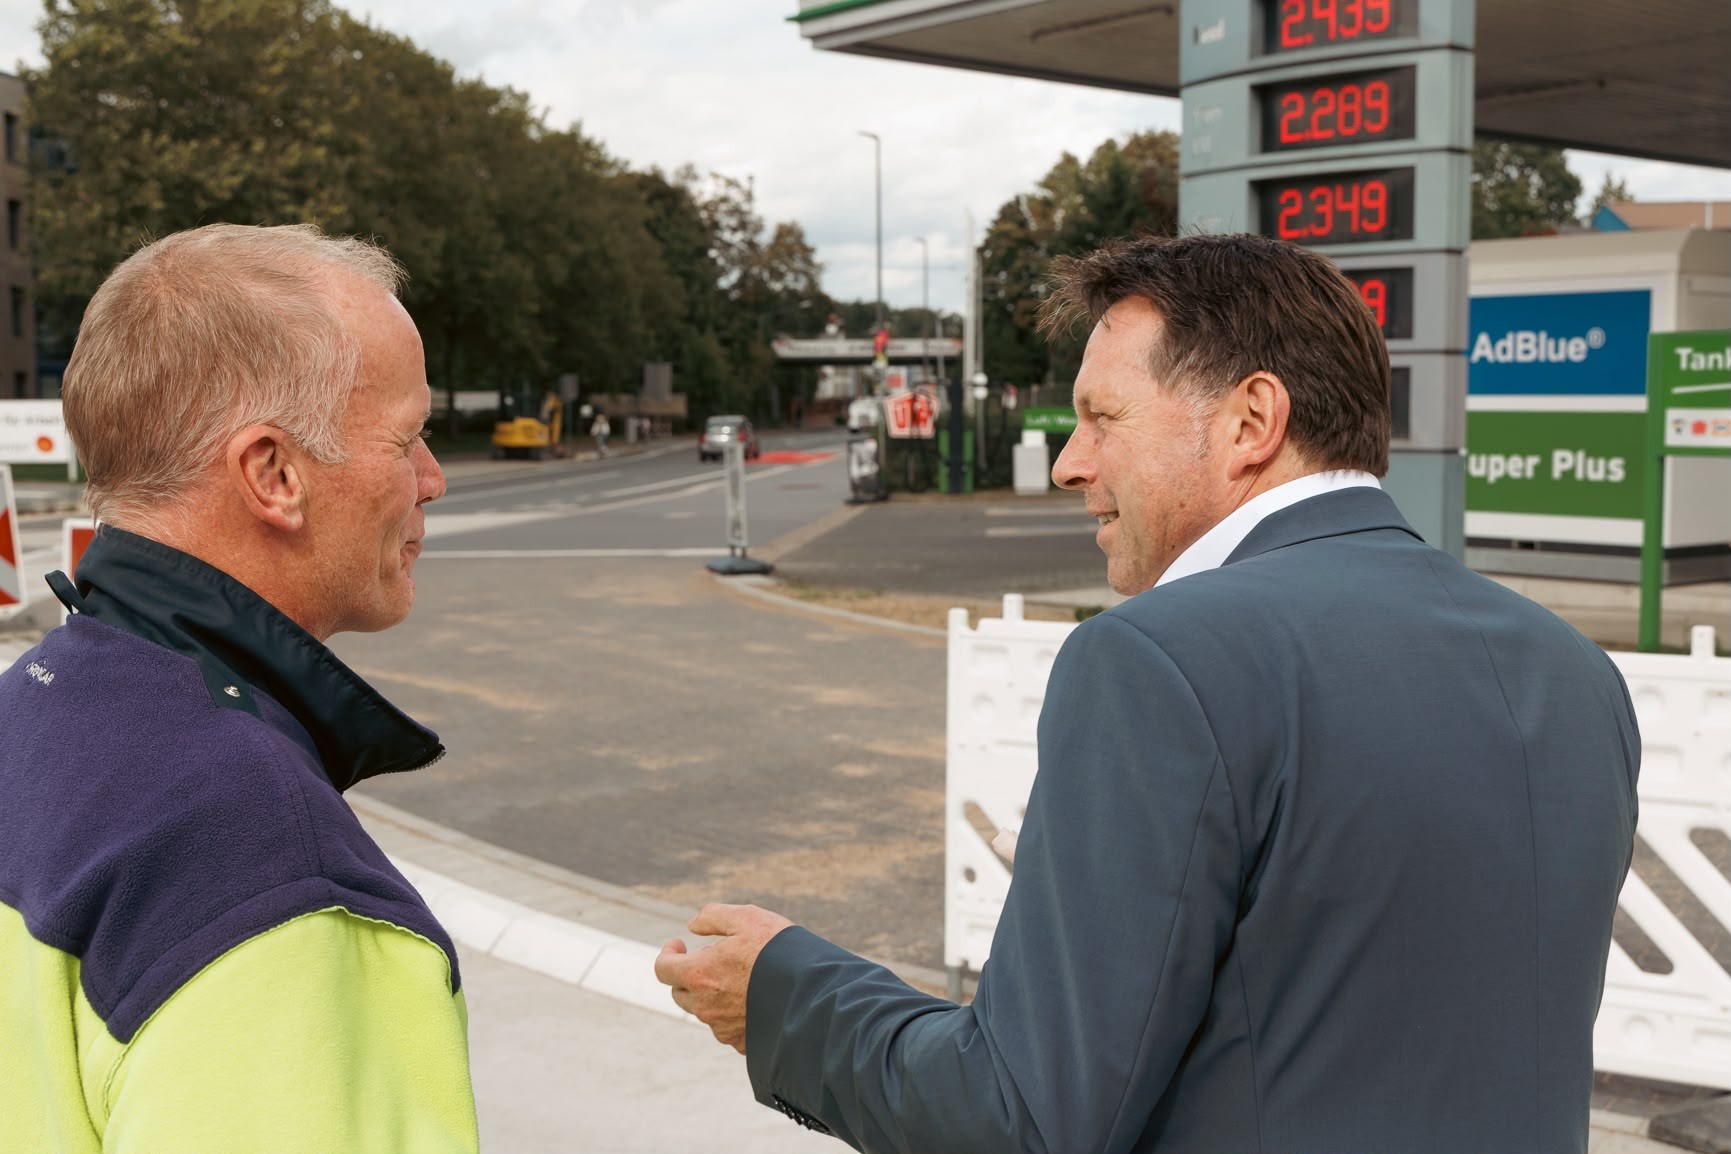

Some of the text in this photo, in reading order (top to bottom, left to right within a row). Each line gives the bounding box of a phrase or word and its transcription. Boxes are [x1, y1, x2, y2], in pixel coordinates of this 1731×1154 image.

[1279, 80, 1390, 144] 2.289
[1278, 180, 1387, 239] 2.349
[1459, 447, 1626, 484] uper Plus
